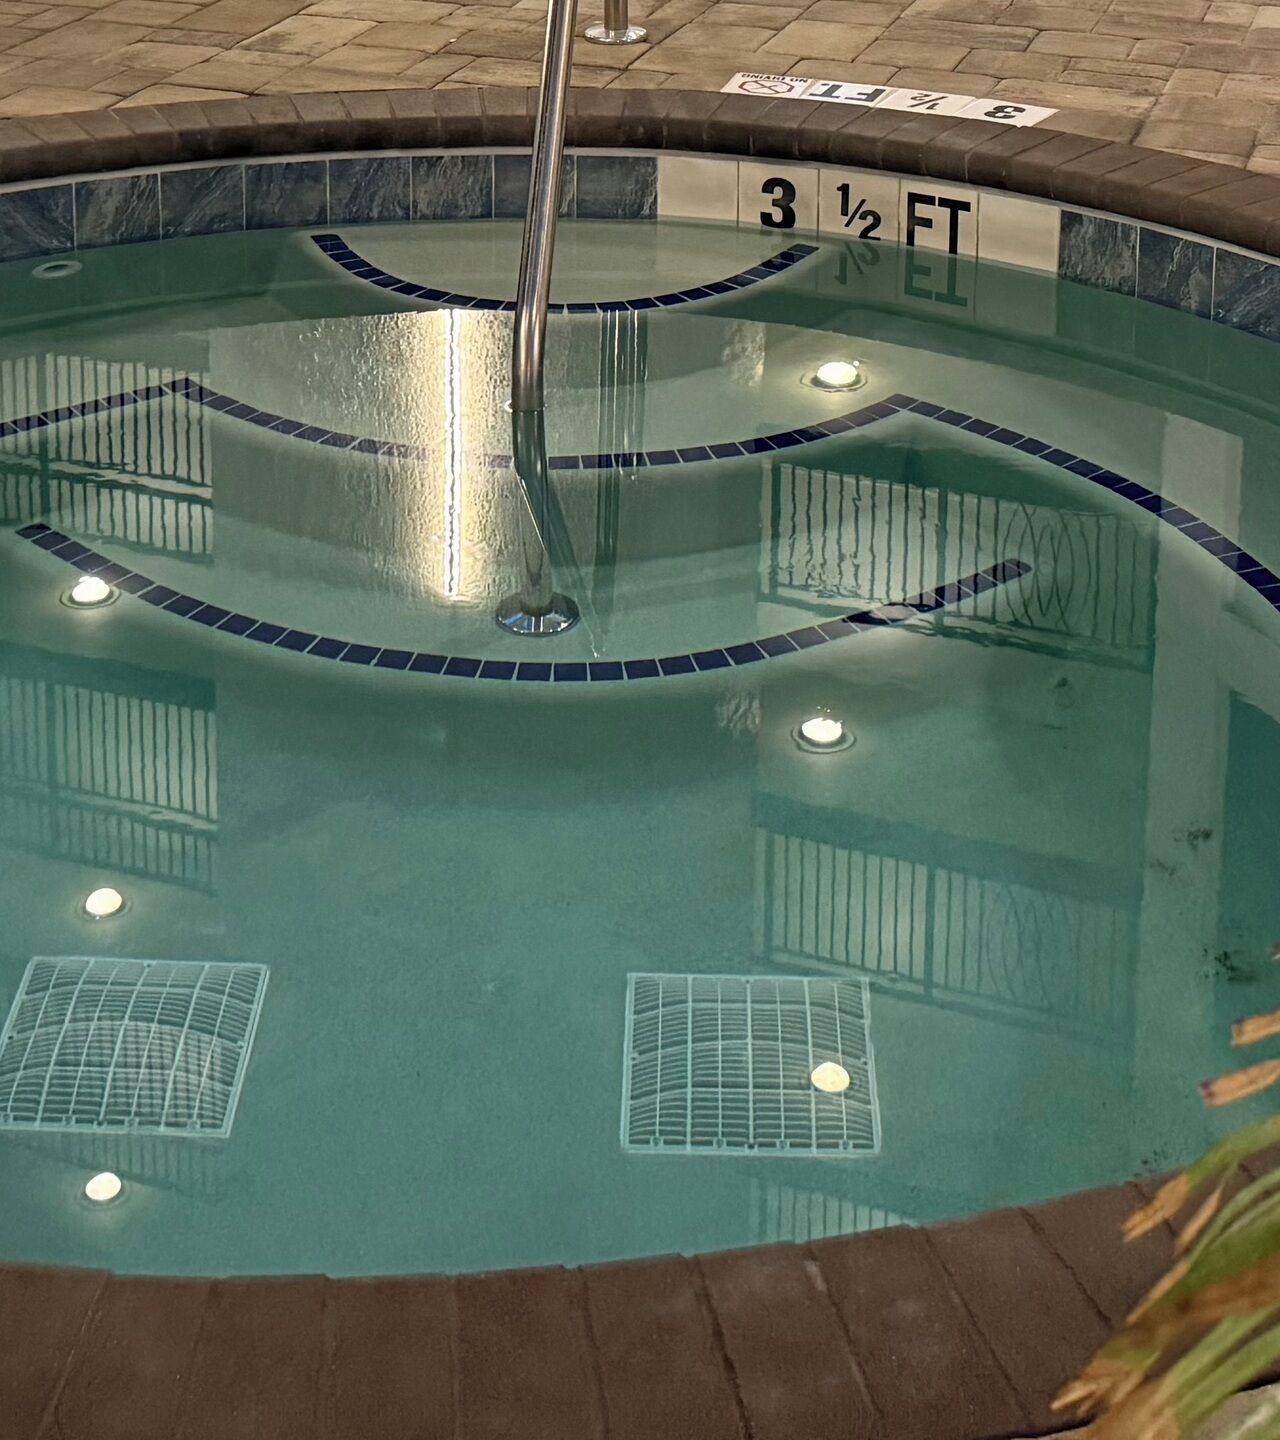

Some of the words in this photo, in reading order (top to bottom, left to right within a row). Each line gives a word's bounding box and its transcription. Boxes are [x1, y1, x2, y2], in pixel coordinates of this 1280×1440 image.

[983, 105, 1027, 120] 3
[759, 177, 797, 229] 3
[906, 192, 972, 254] FT
